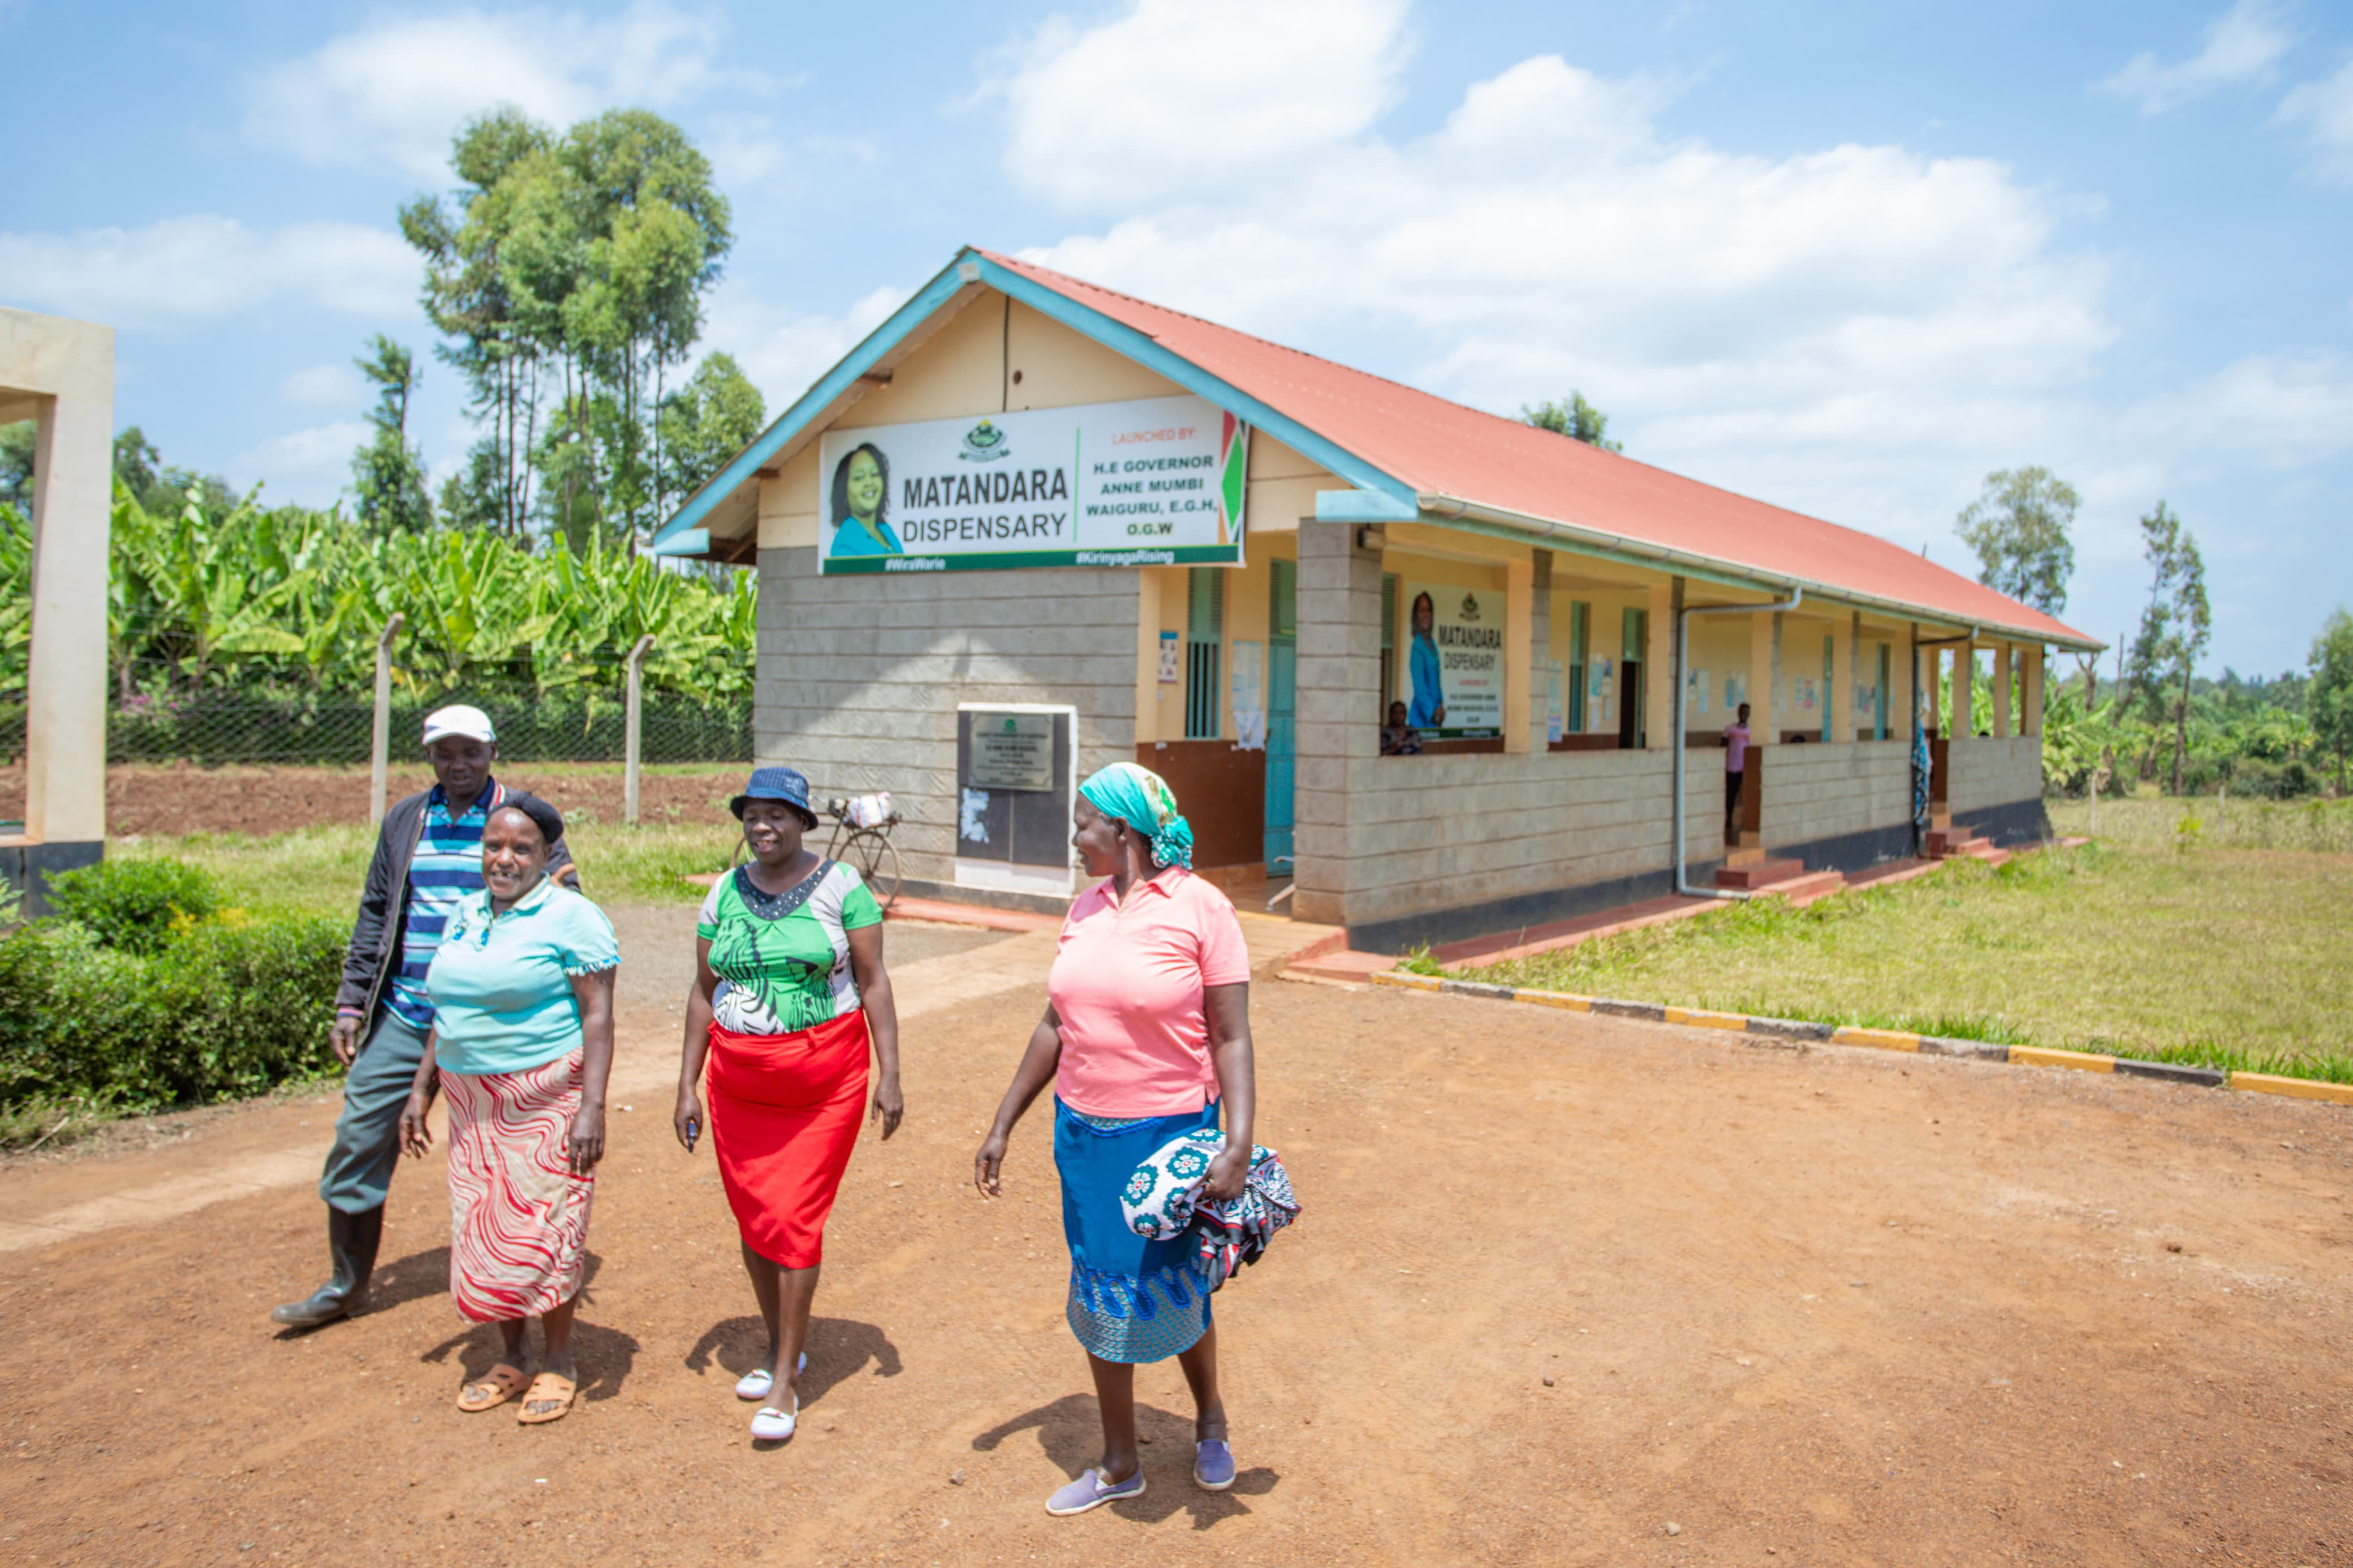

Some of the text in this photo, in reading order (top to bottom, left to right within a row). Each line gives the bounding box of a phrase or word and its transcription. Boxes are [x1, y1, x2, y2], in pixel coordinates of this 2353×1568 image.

[1112, 428, 1175, 445] LAUNCHED
[1093, 455, 1214, 474] H.E GOVERNOR
[904, 468, 1068, 509] MATANDARA
[1101, 478, 1204, 495] ANNE MUMBI
[1086, 502, 1163, 516] WAIGURU,
[904, 512, 1067, 542] DISPENSARY
[1127, 522, 1173, 535] O.G.W
[1076, 550, 1174, 567] #KirinyagaRising
[1437, 624, 1502, 650] MATANDARA
[1444, 651, 1495, 671] DISPENSARY
